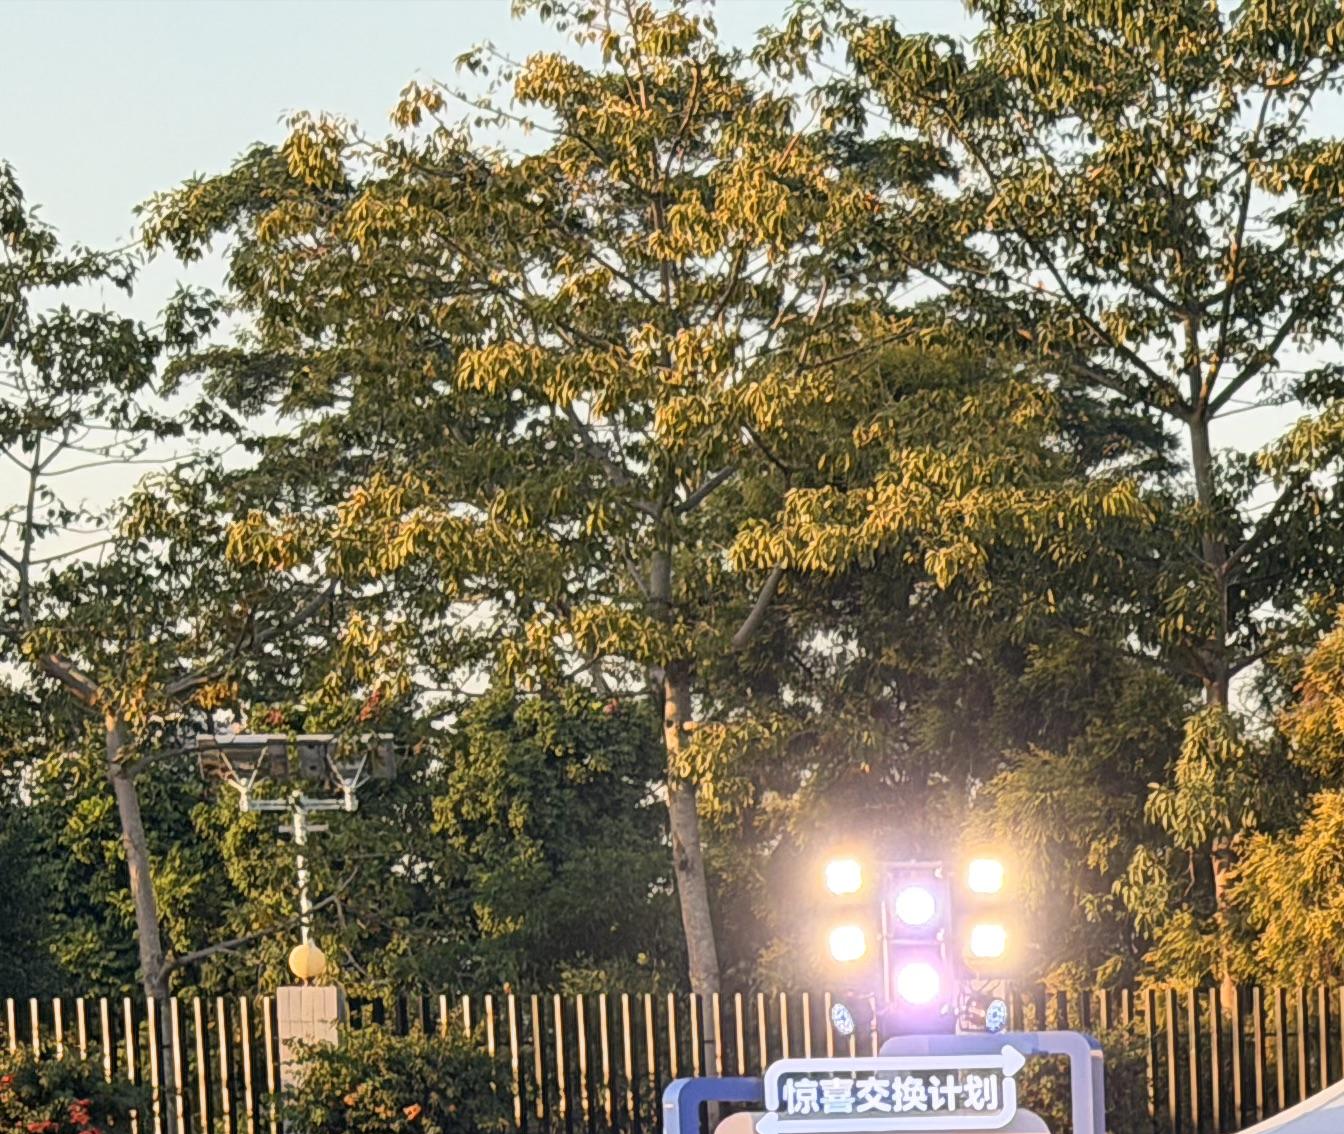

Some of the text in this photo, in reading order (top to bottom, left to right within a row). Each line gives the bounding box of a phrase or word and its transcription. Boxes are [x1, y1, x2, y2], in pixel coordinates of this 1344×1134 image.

[783, 1074, 999, 1114] 惊喜交换计划
